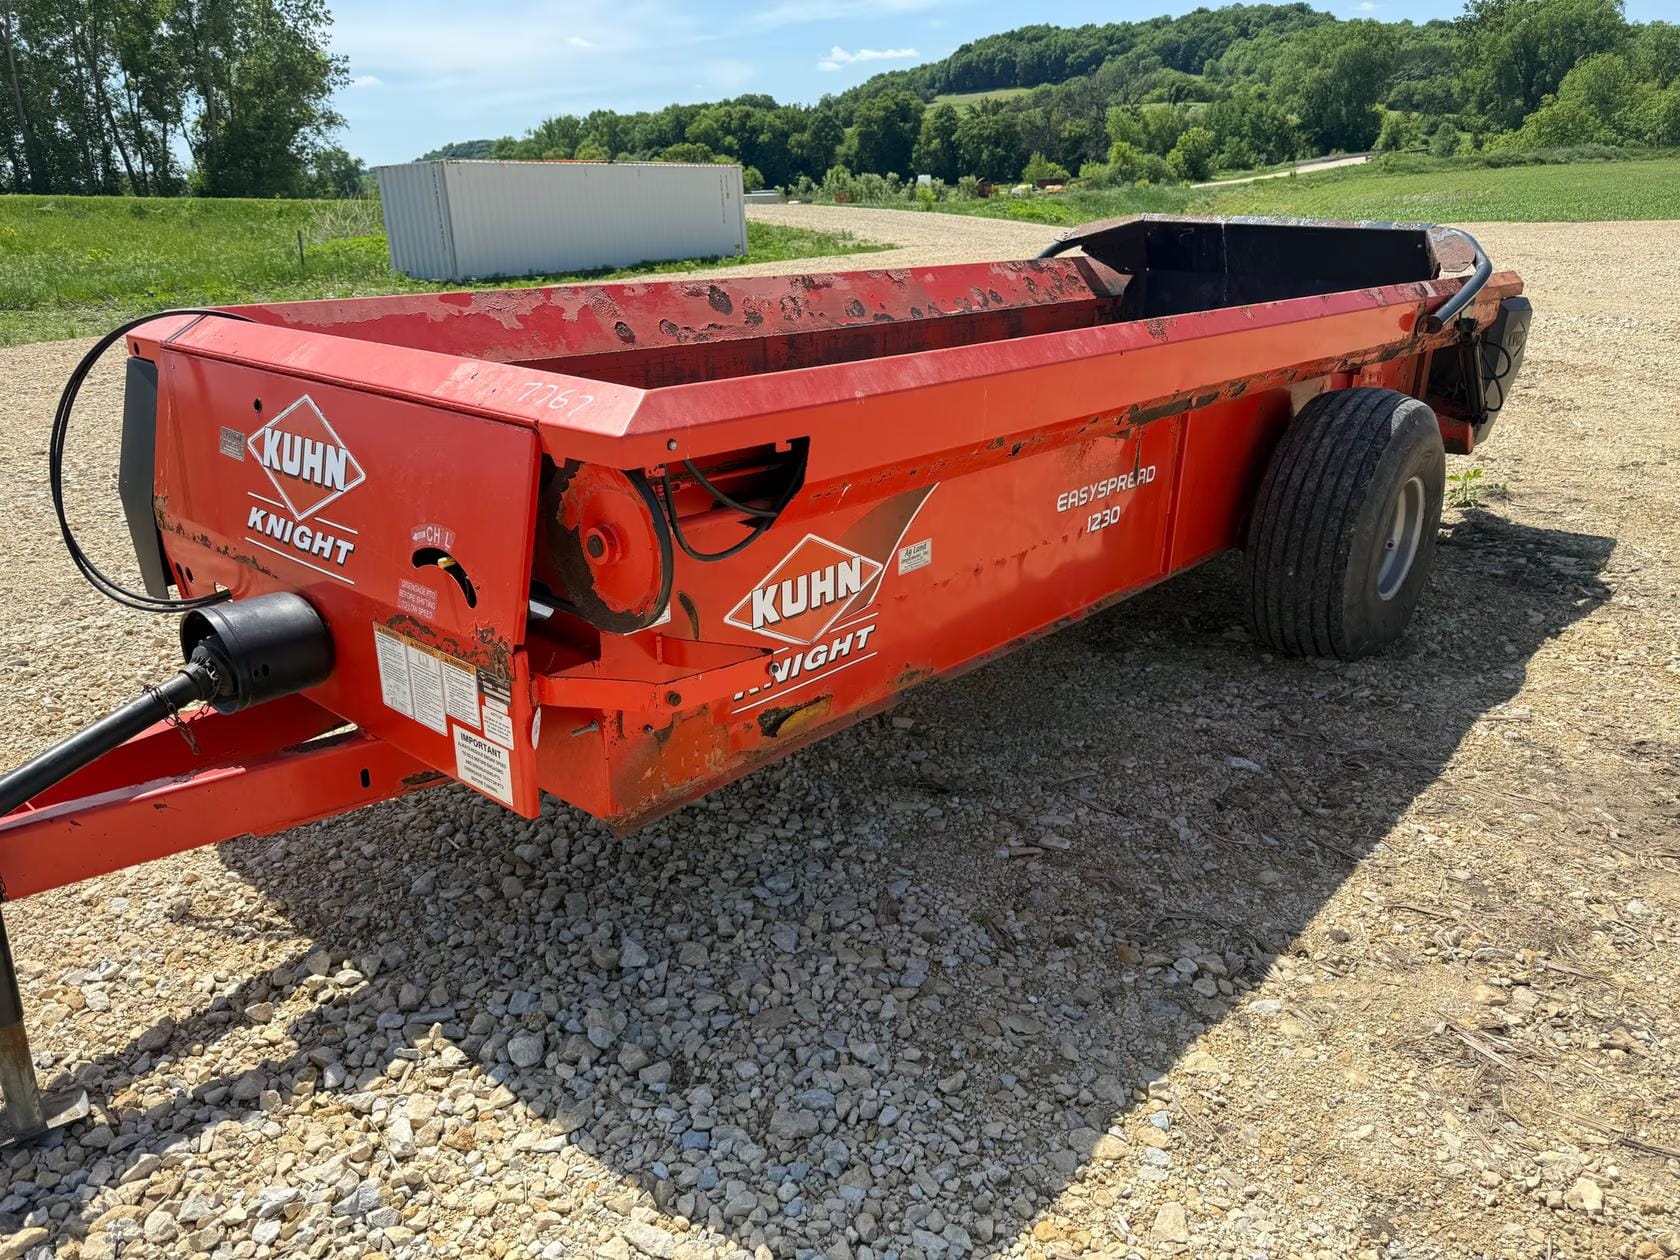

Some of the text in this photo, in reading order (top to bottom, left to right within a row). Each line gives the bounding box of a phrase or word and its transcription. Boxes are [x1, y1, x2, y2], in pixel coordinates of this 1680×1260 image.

[517, 382, 594, 417] 7767
[262, 426, 347, 493] KUHN
[1056, 465, 1156, 513] EASYSPREAD
[247, 506, 355, 566] KNIGHT
[1086, 505, 1121, 533] 1230
[913, 542, 927, 553] Land
[751, 555, 862, 630] KUHN
[460, 732, 502, 759] IMPORTANT
